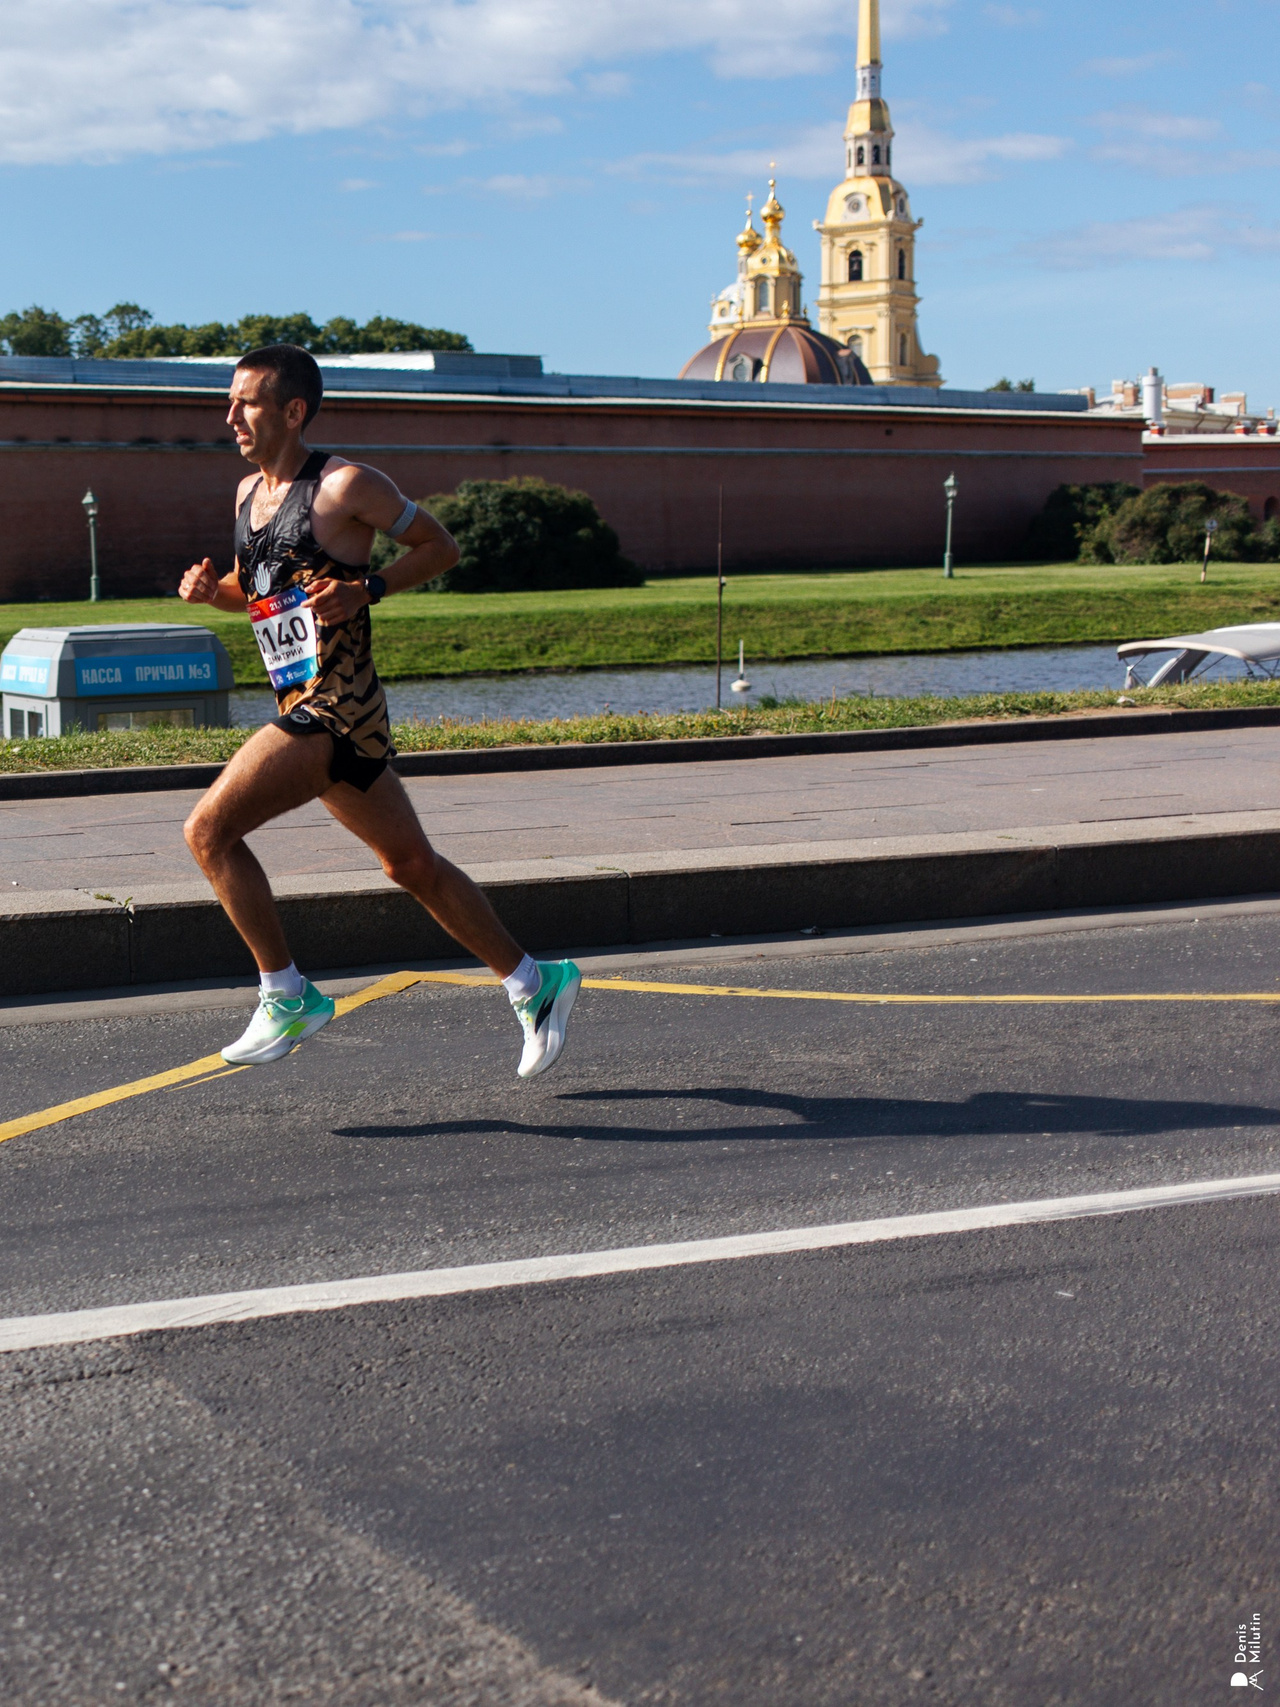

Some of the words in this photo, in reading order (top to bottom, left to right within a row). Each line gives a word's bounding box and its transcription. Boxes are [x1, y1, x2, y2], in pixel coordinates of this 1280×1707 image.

[283, 594, 297, 606] КМ
[268, 645, 304, 666] ДМИТРИЙ
[81, 667, 122, 684] КАССА
[135, 665, 184, 681] ПРИЧАЛ
[188, 663, 211, 679] №3
